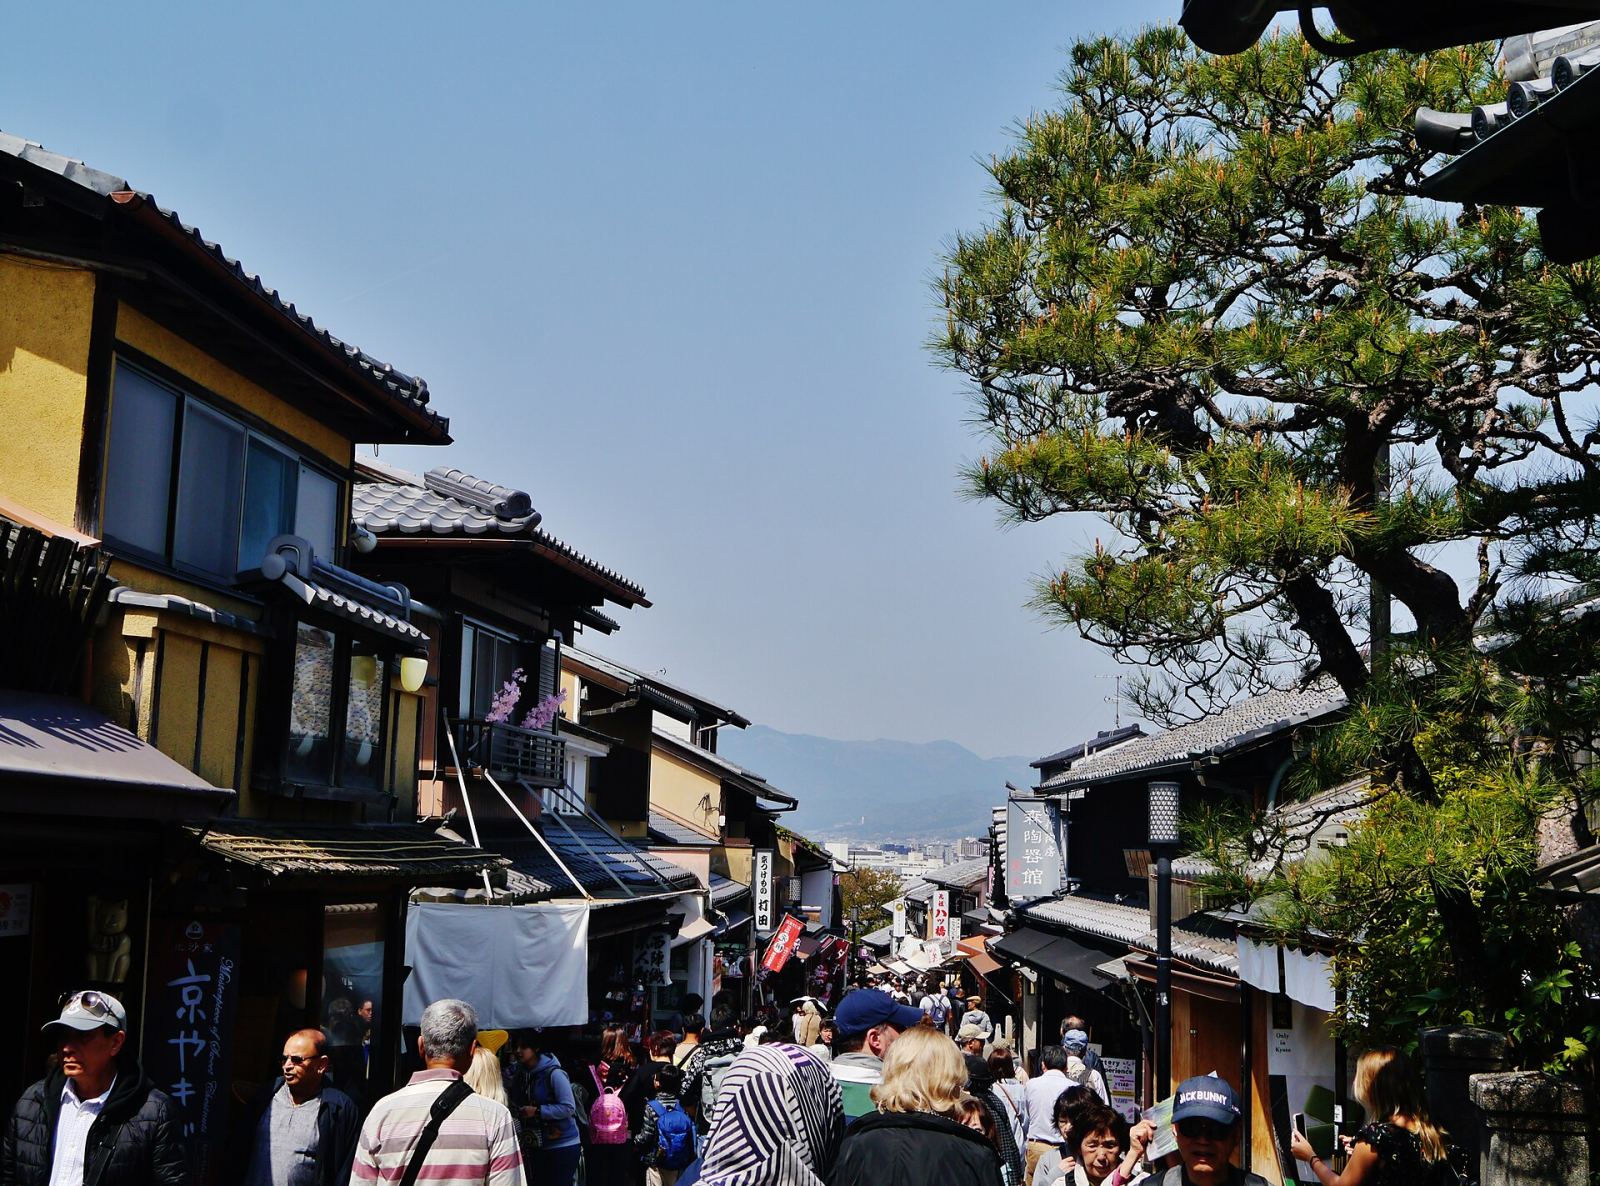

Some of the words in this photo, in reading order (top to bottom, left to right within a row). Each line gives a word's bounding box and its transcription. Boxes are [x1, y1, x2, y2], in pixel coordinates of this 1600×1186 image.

[1276, 1032, 1289, 1040] Only
[1103, 1060, 1121, 1068] tery
[1104, 1067, 1133, 1075] perience
